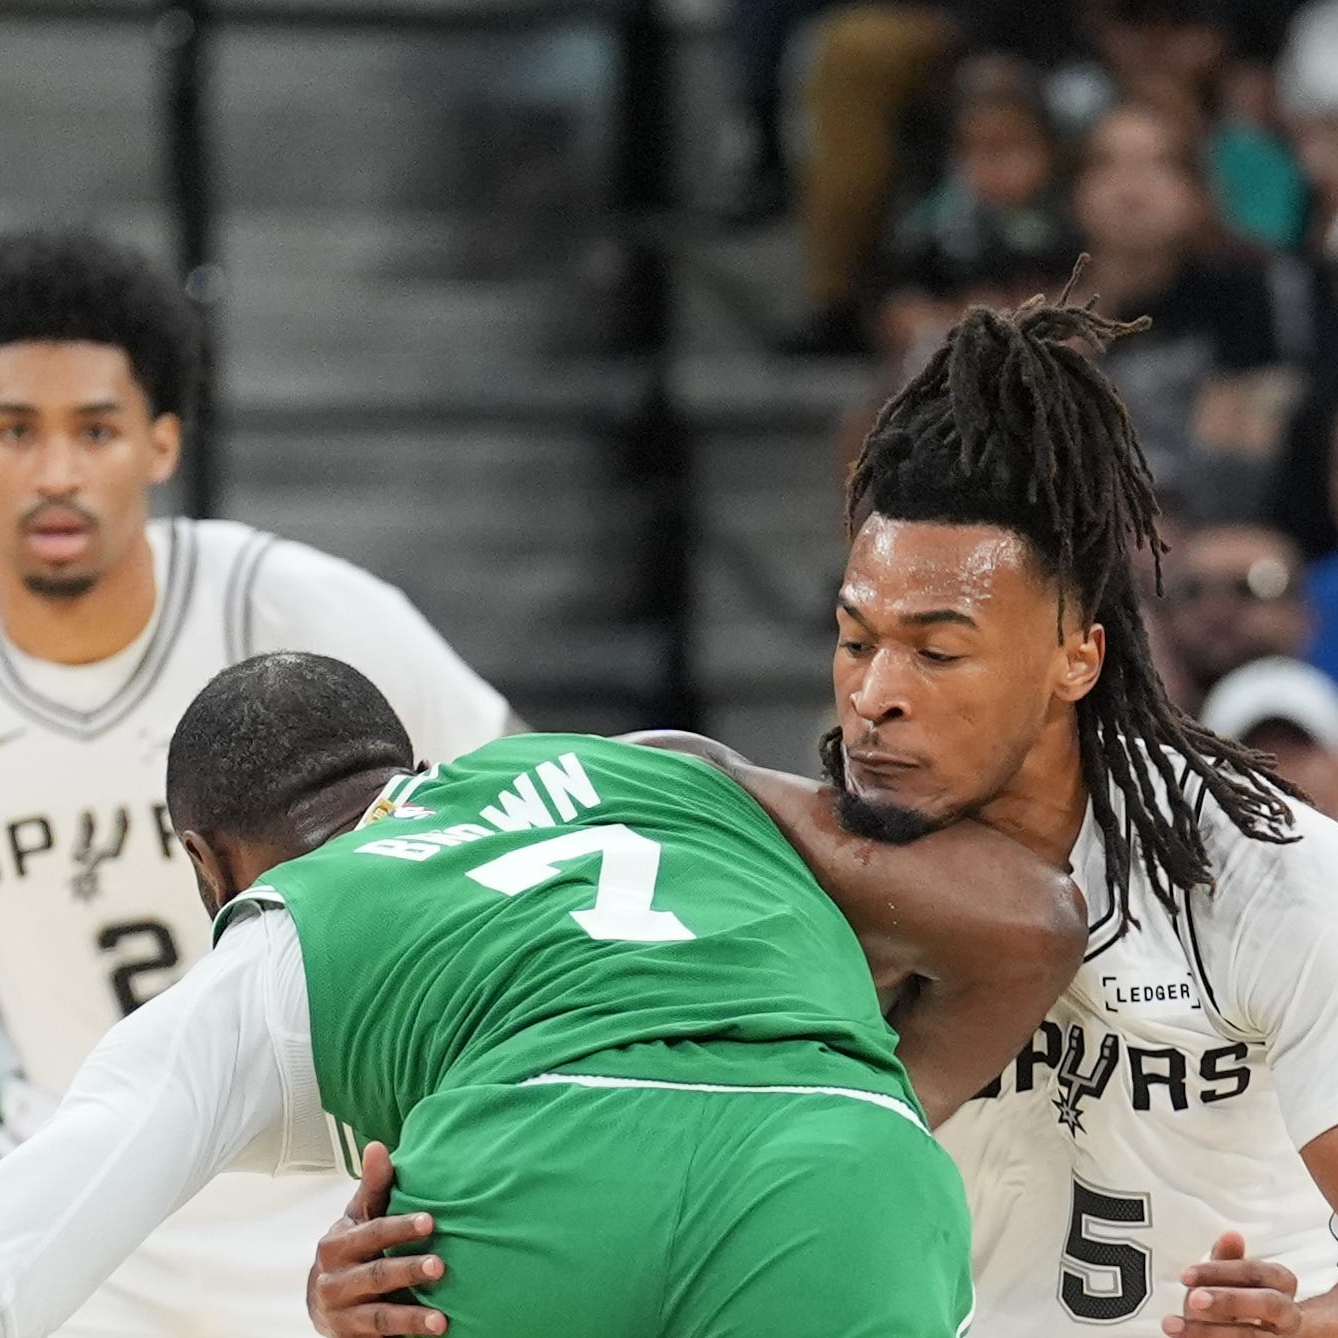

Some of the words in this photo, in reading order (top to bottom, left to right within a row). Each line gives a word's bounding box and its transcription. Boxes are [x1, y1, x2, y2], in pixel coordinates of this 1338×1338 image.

[465, 823, 698, 942] 7
[97, 917, 180, 1018] 2
[1116, 983, 1191, 1003] LEDGER
[969, 1020, 1252, 1138] PURS
[1057, 1168, 1154, 1326] 5
